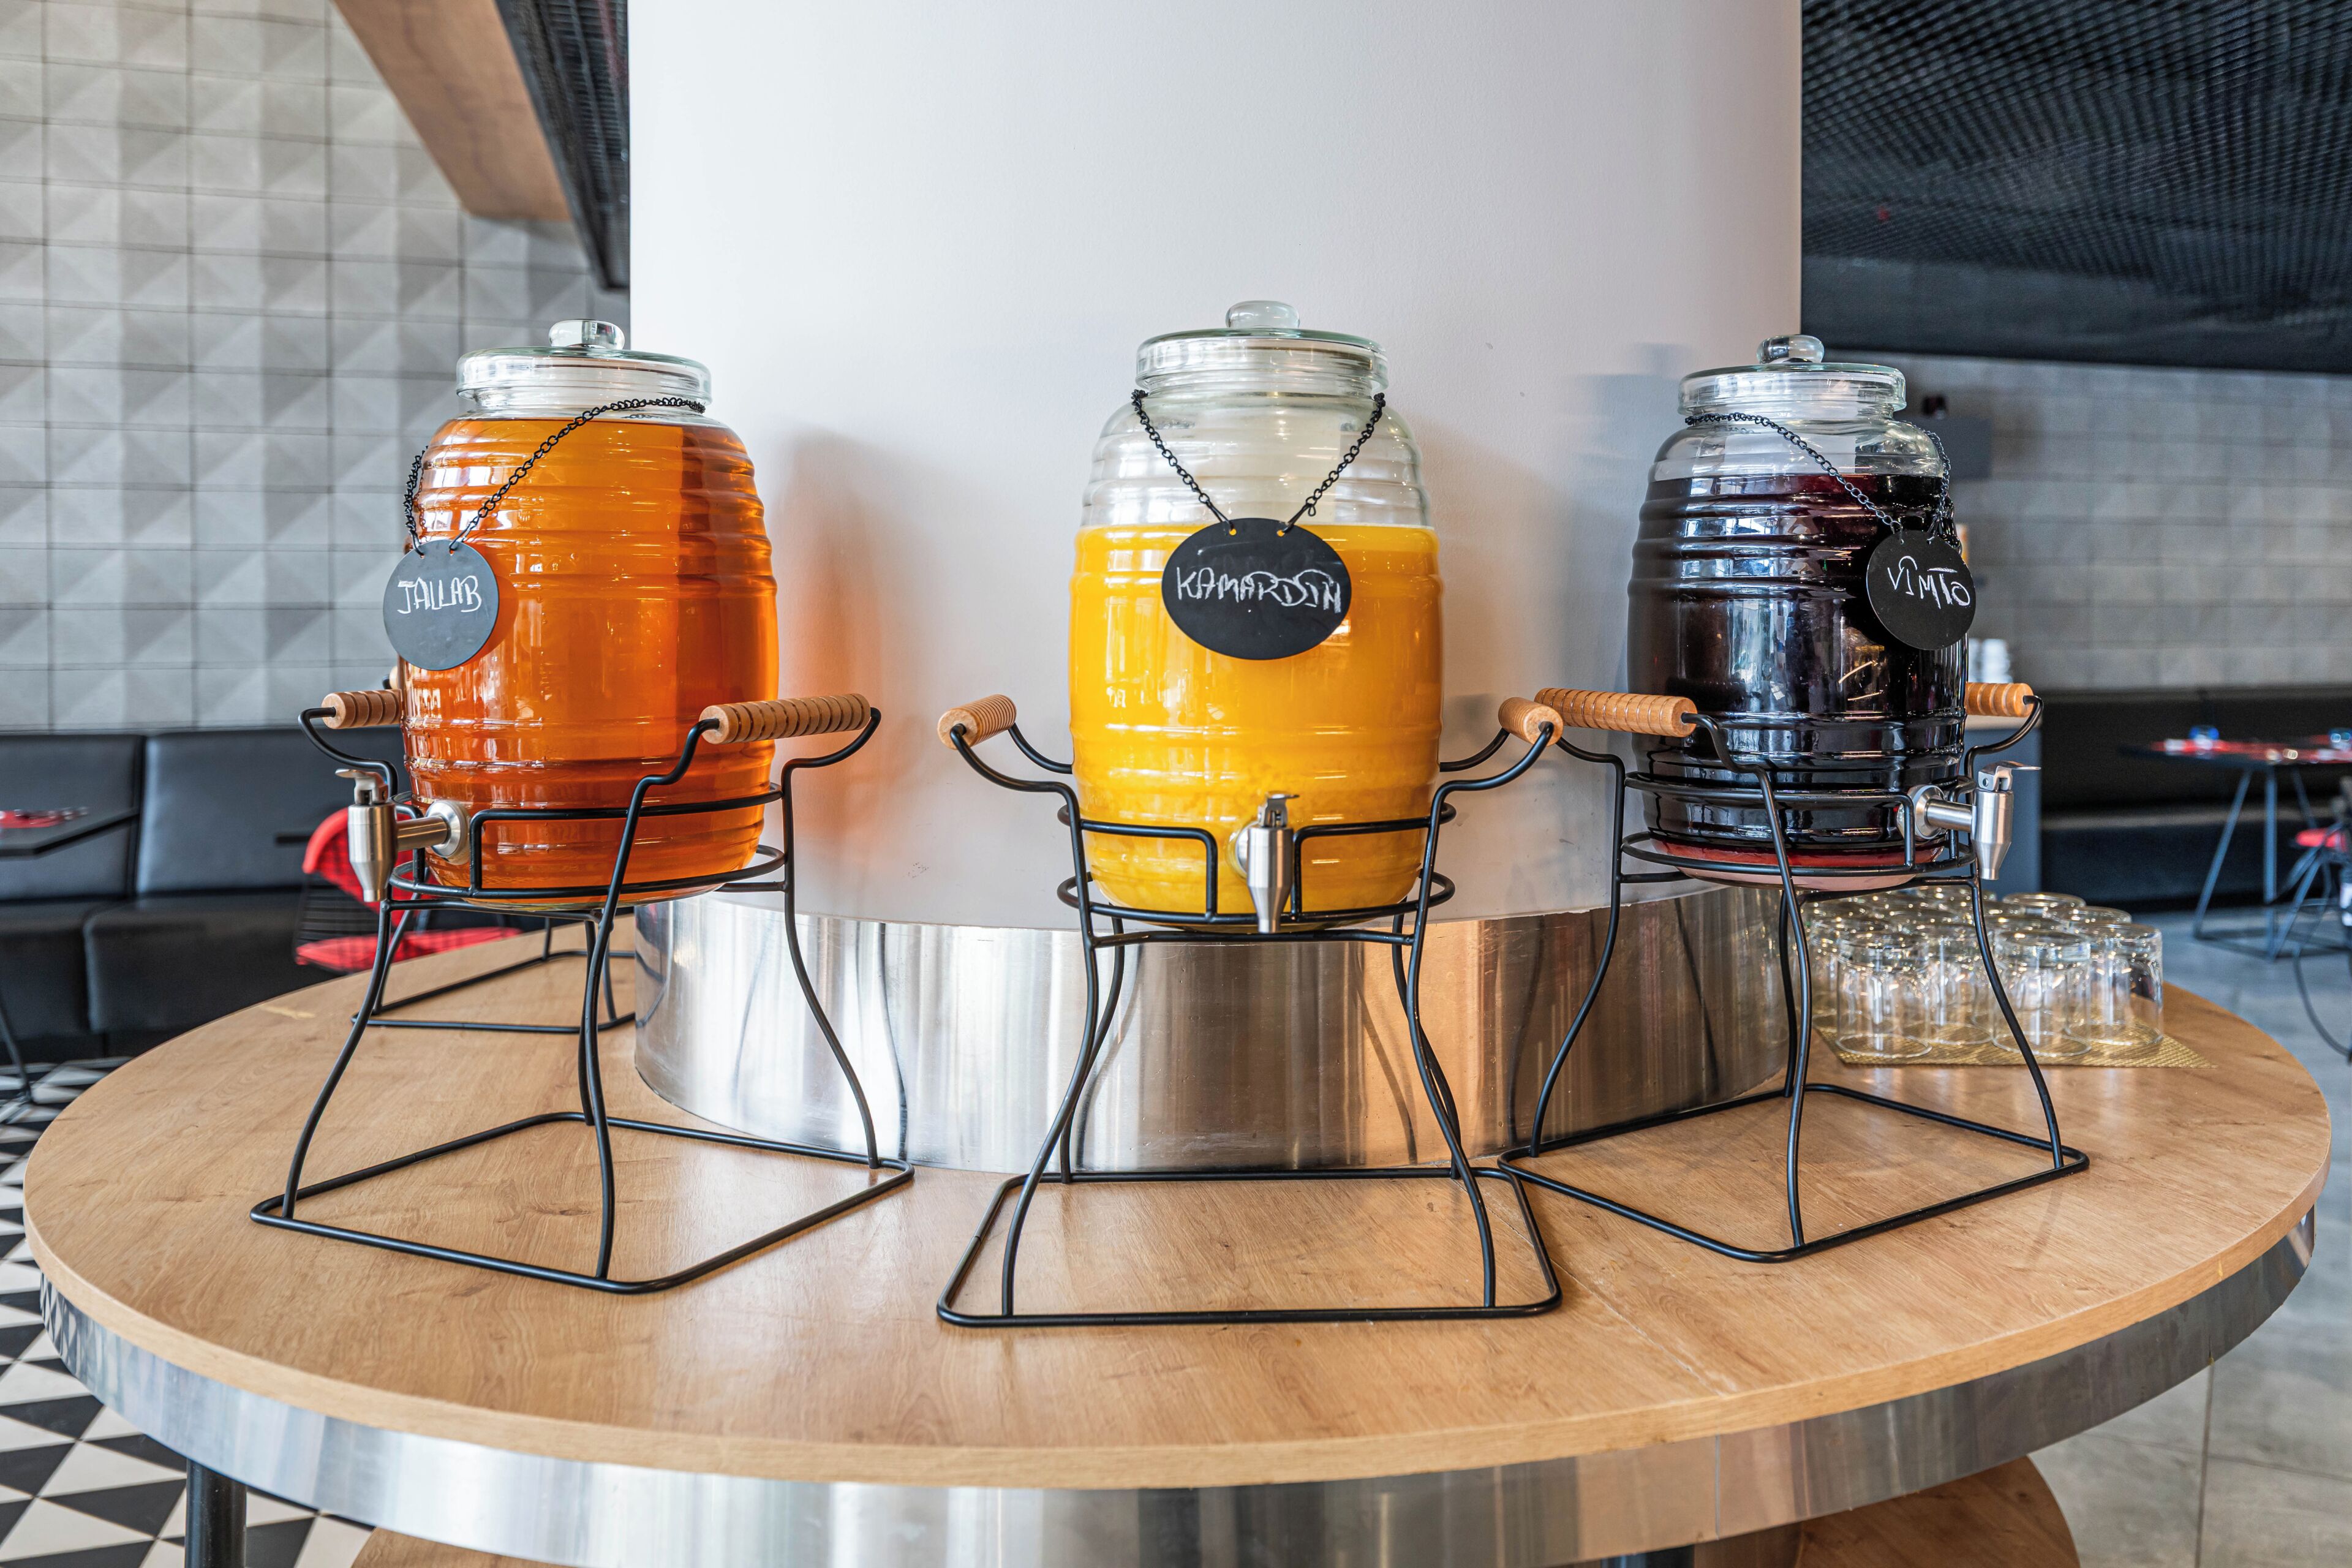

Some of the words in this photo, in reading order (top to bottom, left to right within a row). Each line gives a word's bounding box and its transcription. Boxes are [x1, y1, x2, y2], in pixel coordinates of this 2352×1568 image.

[397, 575, 482, 614] JALLAB
[1176, 567, 1341, 613] KAMARDIN
[1887, 556, 1970, 609] VIMTO
